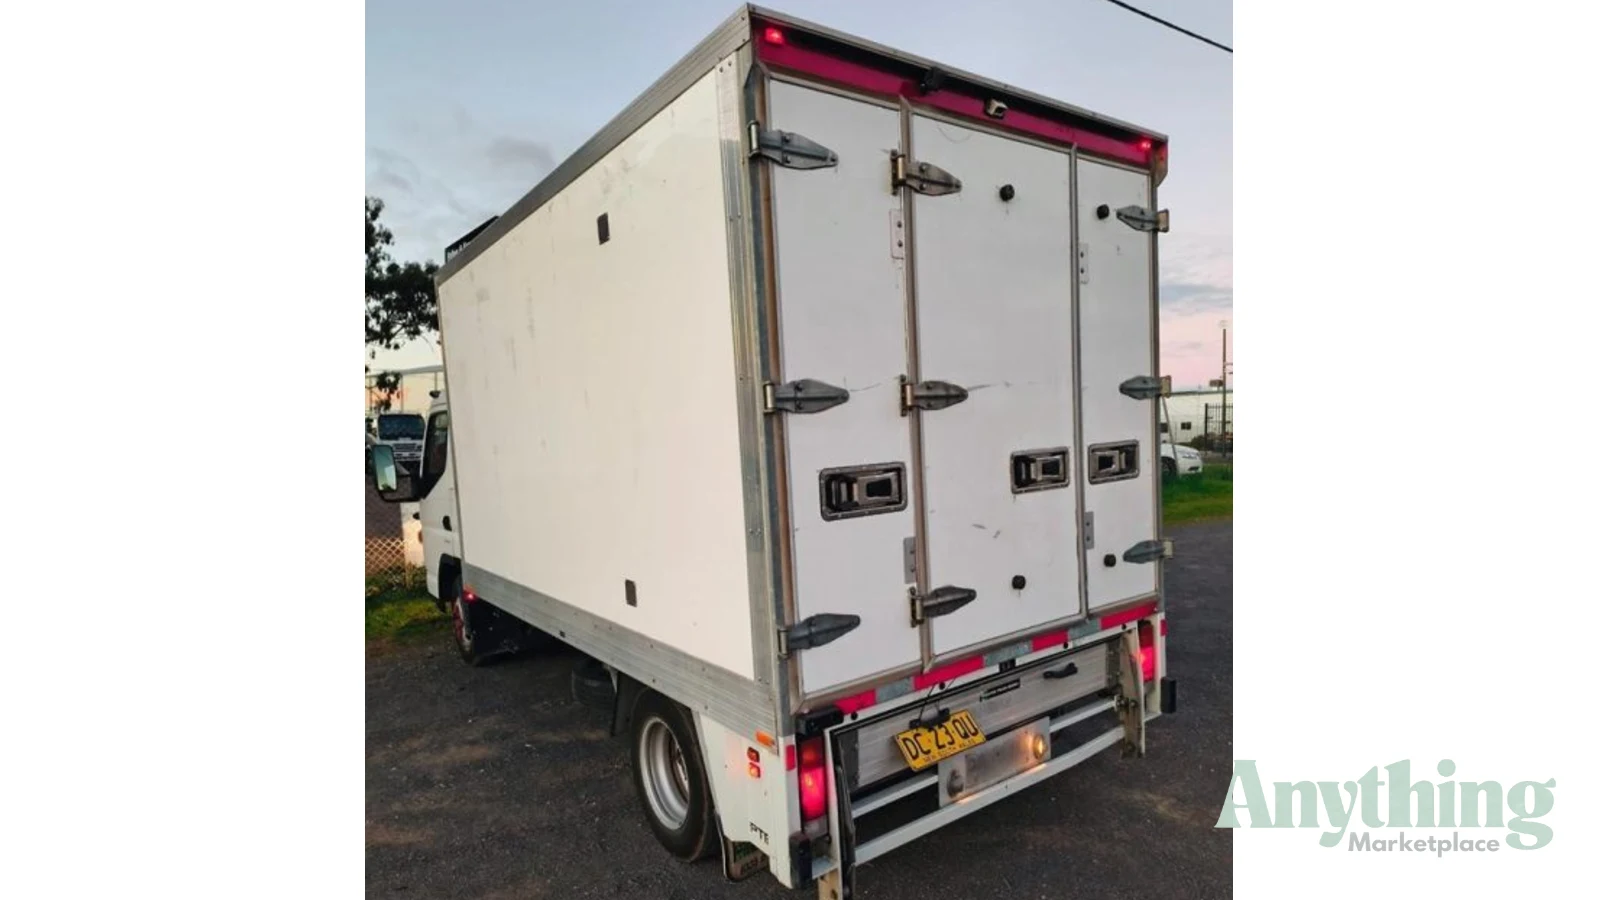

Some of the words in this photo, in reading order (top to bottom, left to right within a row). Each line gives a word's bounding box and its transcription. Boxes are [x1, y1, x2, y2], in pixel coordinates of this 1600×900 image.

[901, 732, 931, 760] DC
[928, 724, 955, 749] 23
[952, 715, 979, 739] QU
